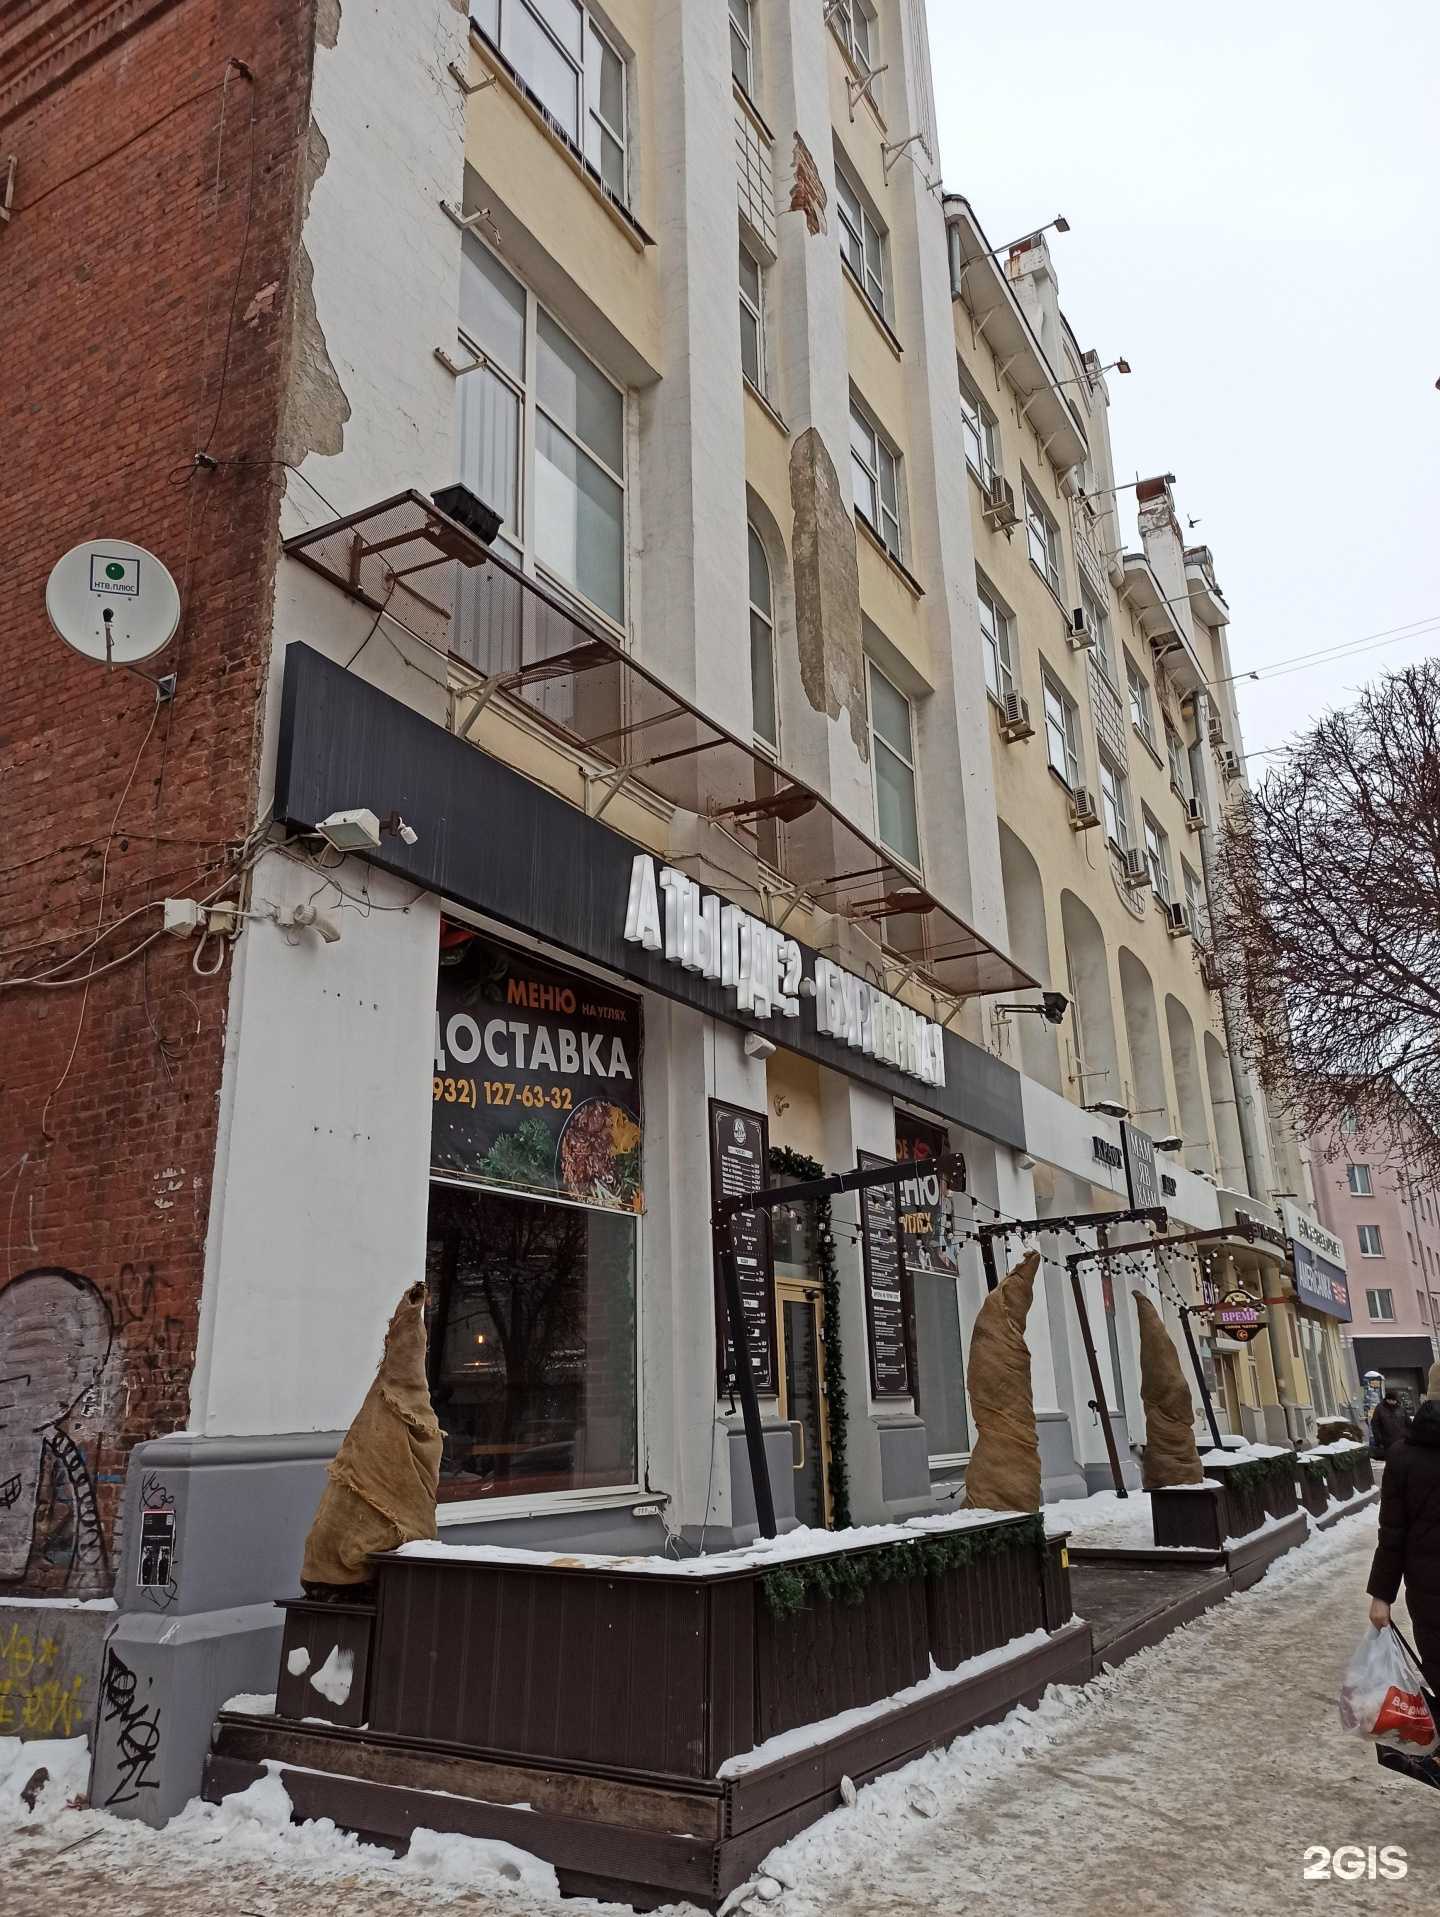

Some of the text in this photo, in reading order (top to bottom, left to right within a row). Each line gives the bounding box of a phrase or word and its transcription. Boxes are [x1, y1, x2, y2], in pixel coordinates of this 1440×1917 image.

[507, 978, 577, 1014] МЕНЮ
[582, 1003, 597, 1016] НА
[484, 1081, 573, 1110] 127-63-32
[1221, 1309, 1258, 1322] ВРЕМЯ
